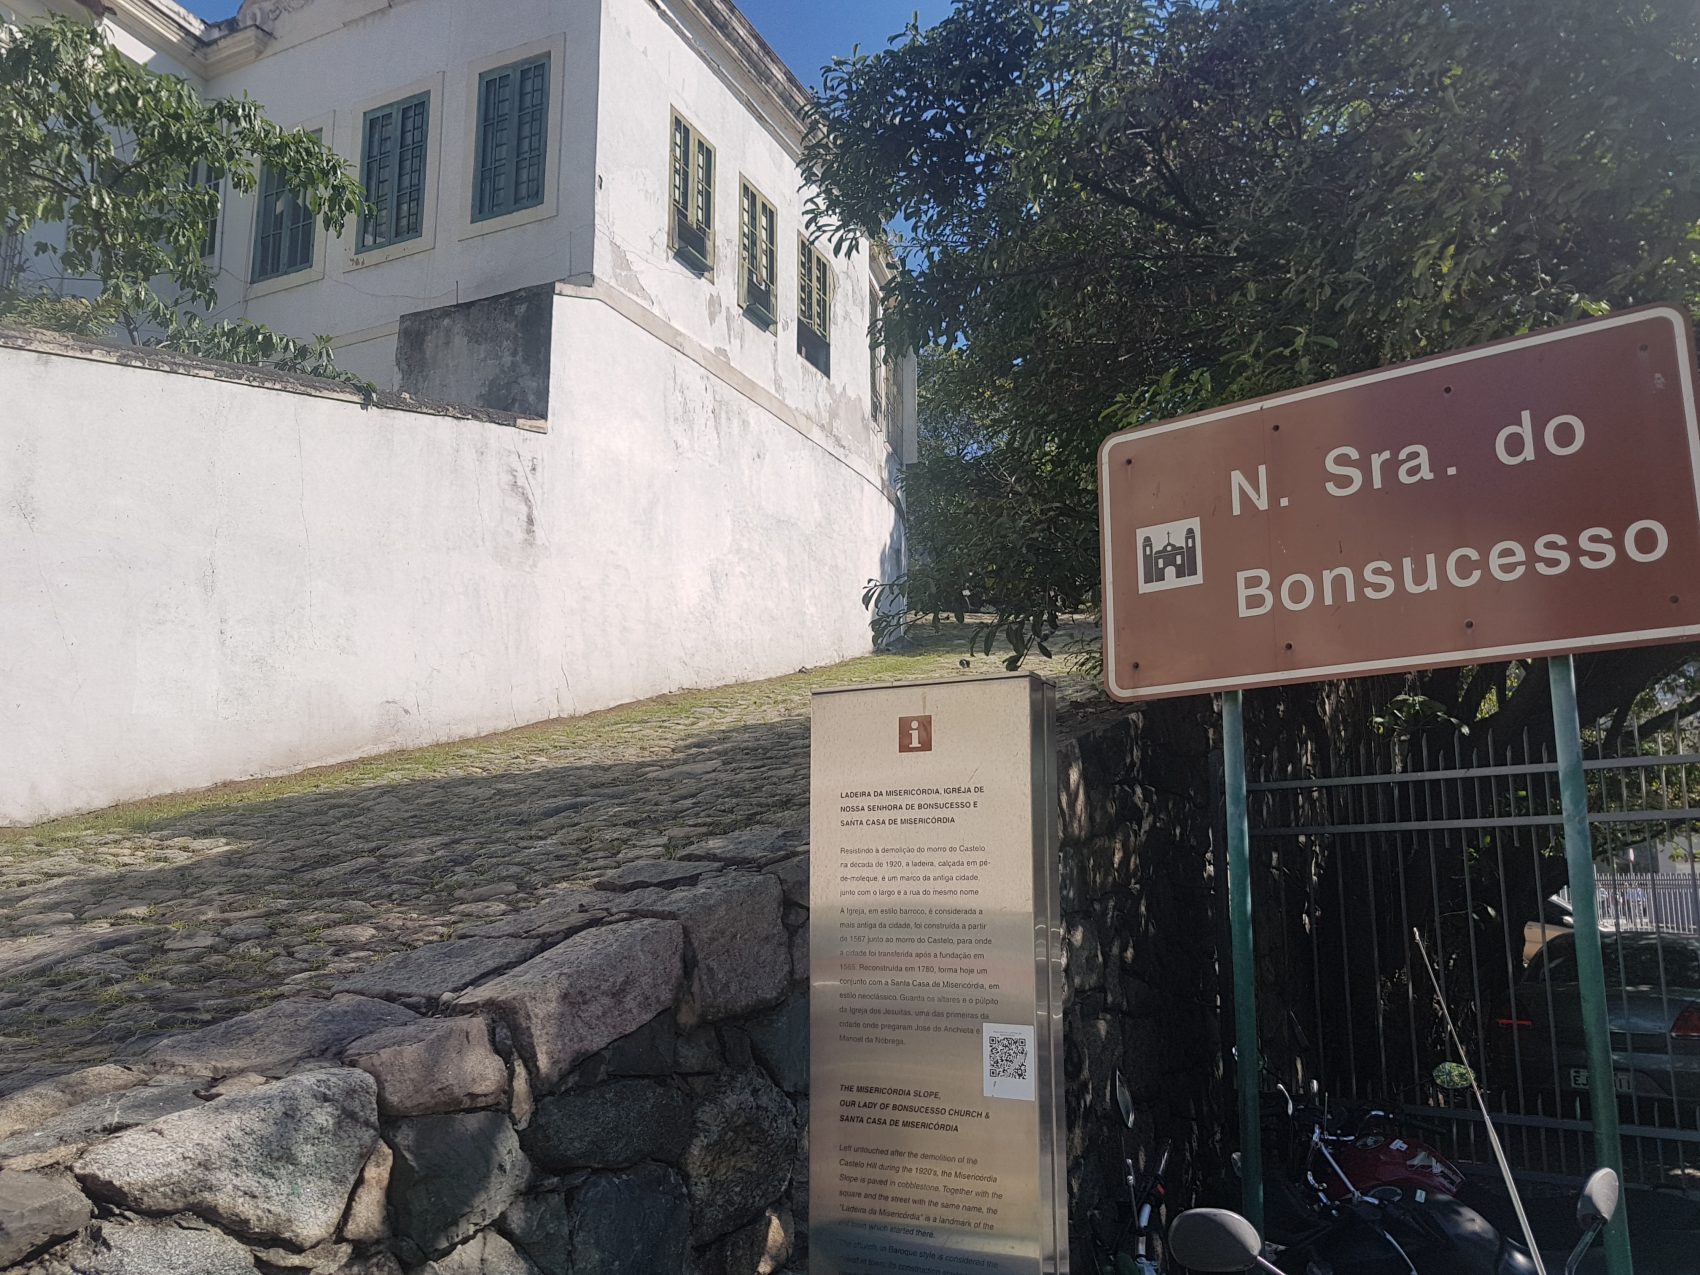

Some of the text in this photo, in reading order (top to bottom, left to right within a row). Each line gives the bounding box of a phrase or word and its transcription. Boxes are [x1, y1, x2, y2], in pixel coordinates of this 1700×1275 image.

[1230, 409, 1586, 516] N. Sra. do
[1236, 519, 1669, 618] Bonsucesso
[918, 802, 971, 810] BONSUCESSO
[900, 816, 955, 825] MISERICÓRDIA
[940, 952, 971, 960] fundação
[840, 1084, 854, 1092] THE
[913, 1090, 941, 1100] SLOPE,
[858, 1101, 878, 1109] LADY
[892, 1104, 946, 1115] BONSUCESSO
[948, 1109, 982, 1118] CHURCH
[840, 1115, 864, 1123] SANTA
[866, 1117, 887, 1126] CASA
[902, 1120, 959, 1132] MISERICÓRDIA
[854, 1147, 888, 1155] untouched
[920, 1152, 956, 1162] demolition
[839, 1159, 864, 1167] Castelo
[879, 1163, 900, 1173] during
[839, 1174, 858, 1183] Slope
[943, 1186, 973, 1196] Together
[939, 1216, 972, 1227] landmark
